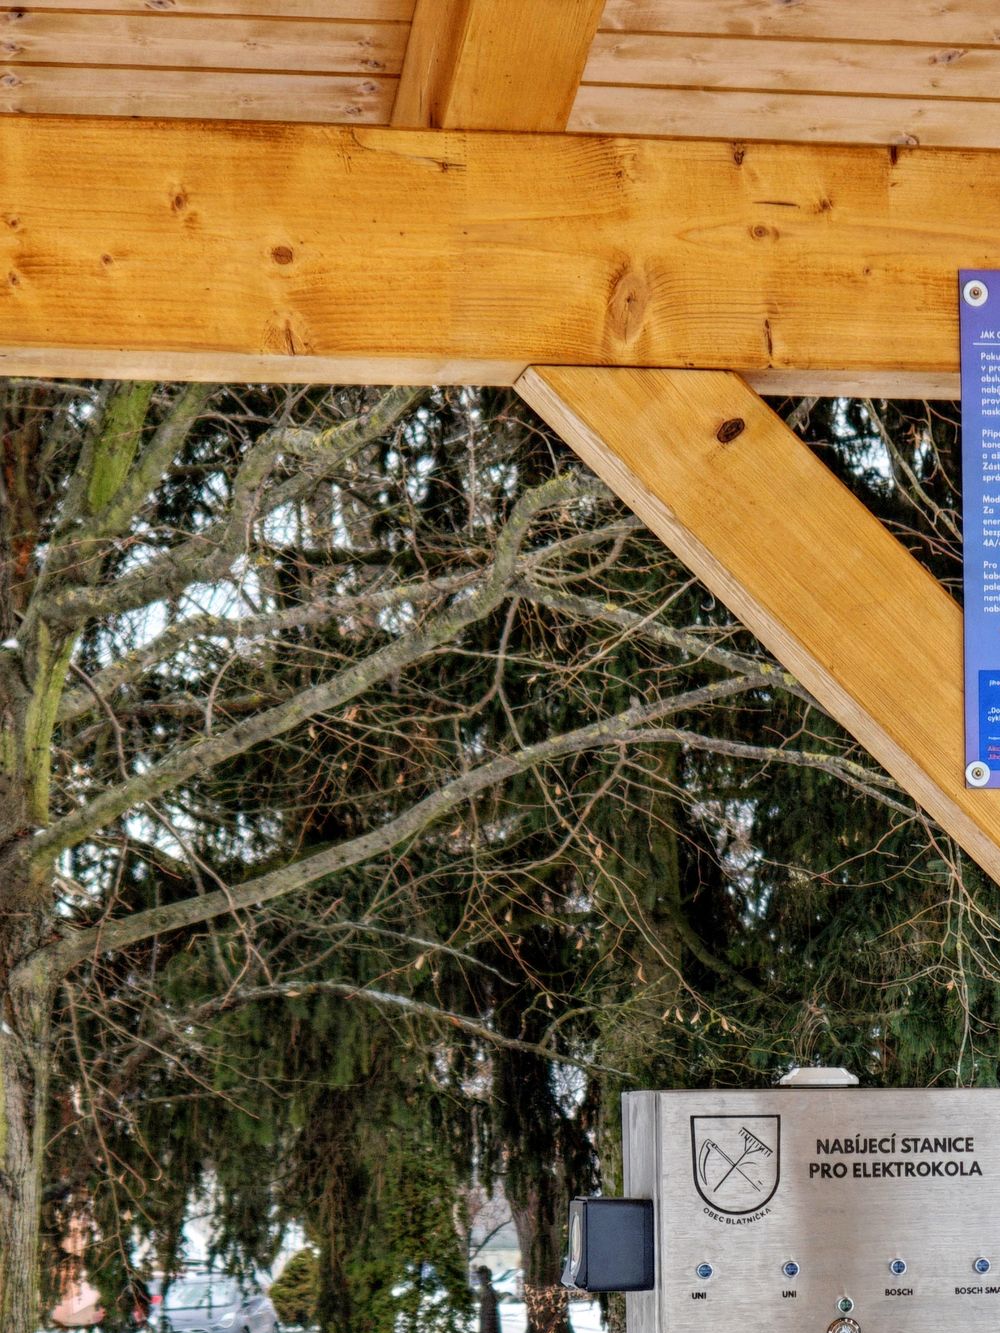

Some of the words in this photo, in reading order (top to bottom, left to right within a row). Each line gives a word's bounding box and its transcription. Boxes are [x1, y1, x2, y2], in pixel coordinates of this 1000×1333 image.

[980, 331, 995, 339] JAK
[816, 1133, 896, 1155] NABÍJECÍ
[901, 1137, 974, 1153] STANICE
[809, 1162, 847, 1178] PRO
[852, 1161, 982, 1178] ELEKTROKOLA
[703, 1207, 723, 1222] OBEC
[726, 1207, 771, 1224] BLATNIČKA
